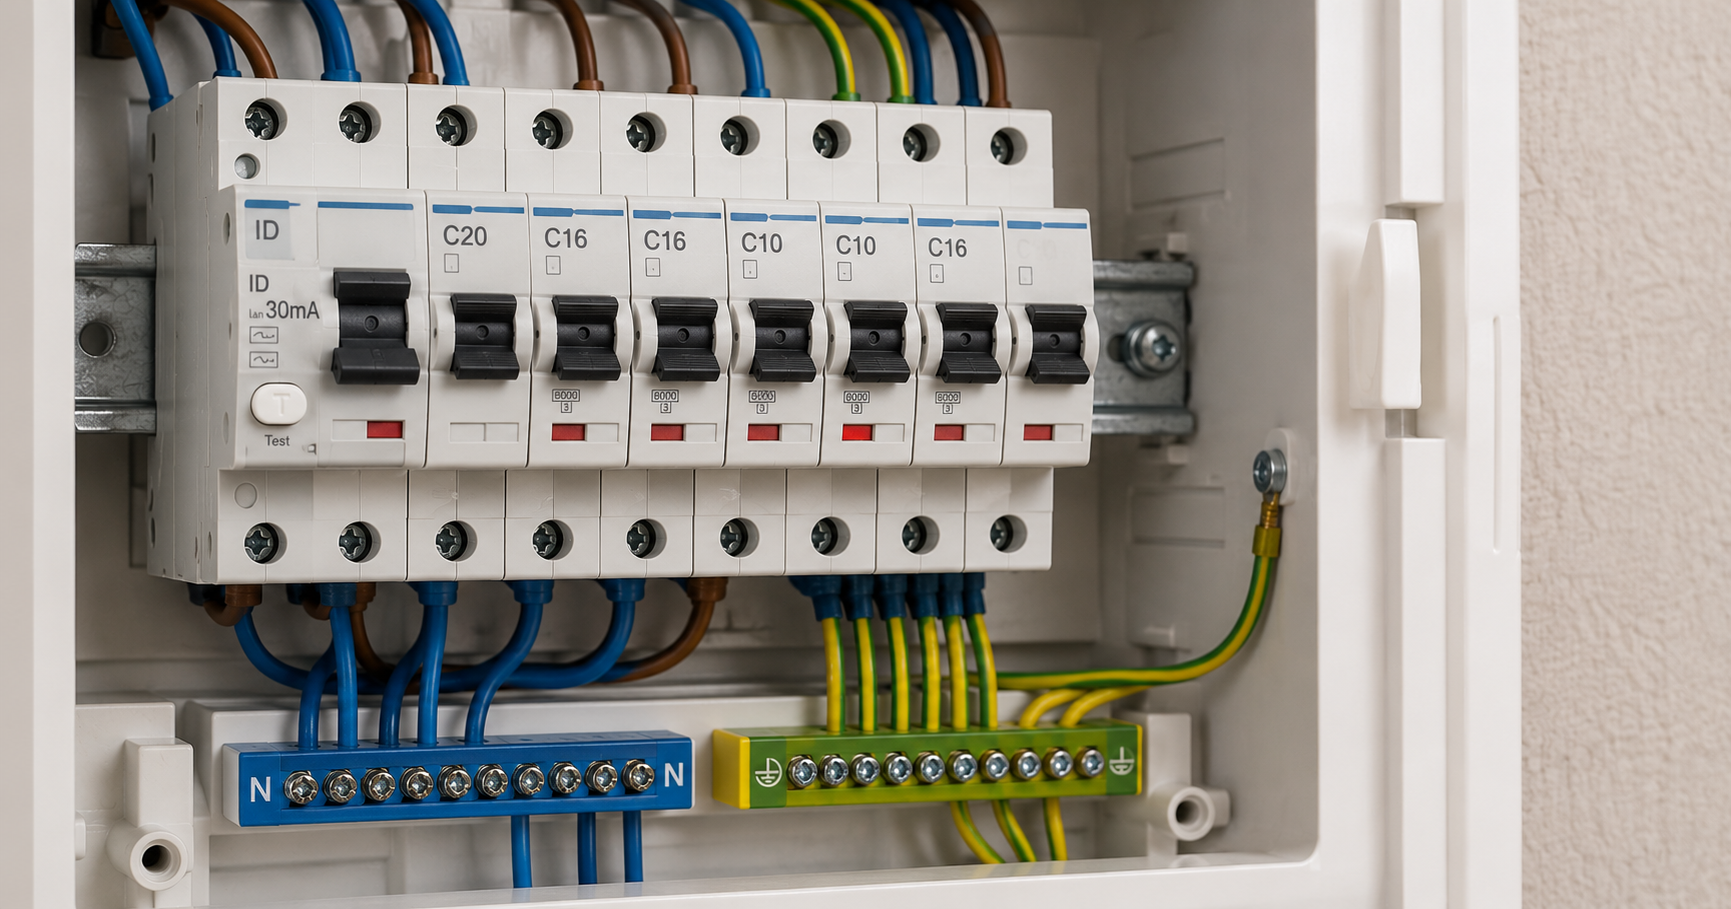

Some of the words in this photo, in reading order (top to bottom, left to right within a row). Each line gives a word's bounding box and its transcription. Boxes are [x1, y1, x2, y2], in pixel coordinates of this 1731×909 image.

[255, 219, 280, 241] ID
[443, 225, 488, 247] C20
[544, 227, 588, 249] C16
[643, 229, 687, 251] C16
[741, 232, 783, 253] C10
[836, 234, 876, 256] C10
[928, 237, 968, 258] C16
[249, 274, 270, 293] ID
[265, 299, 320, 320] 30mA
[264, 434, 290, 447] Test
[664, 762, 684, 788] N
[250, 776, 271, 802] N
